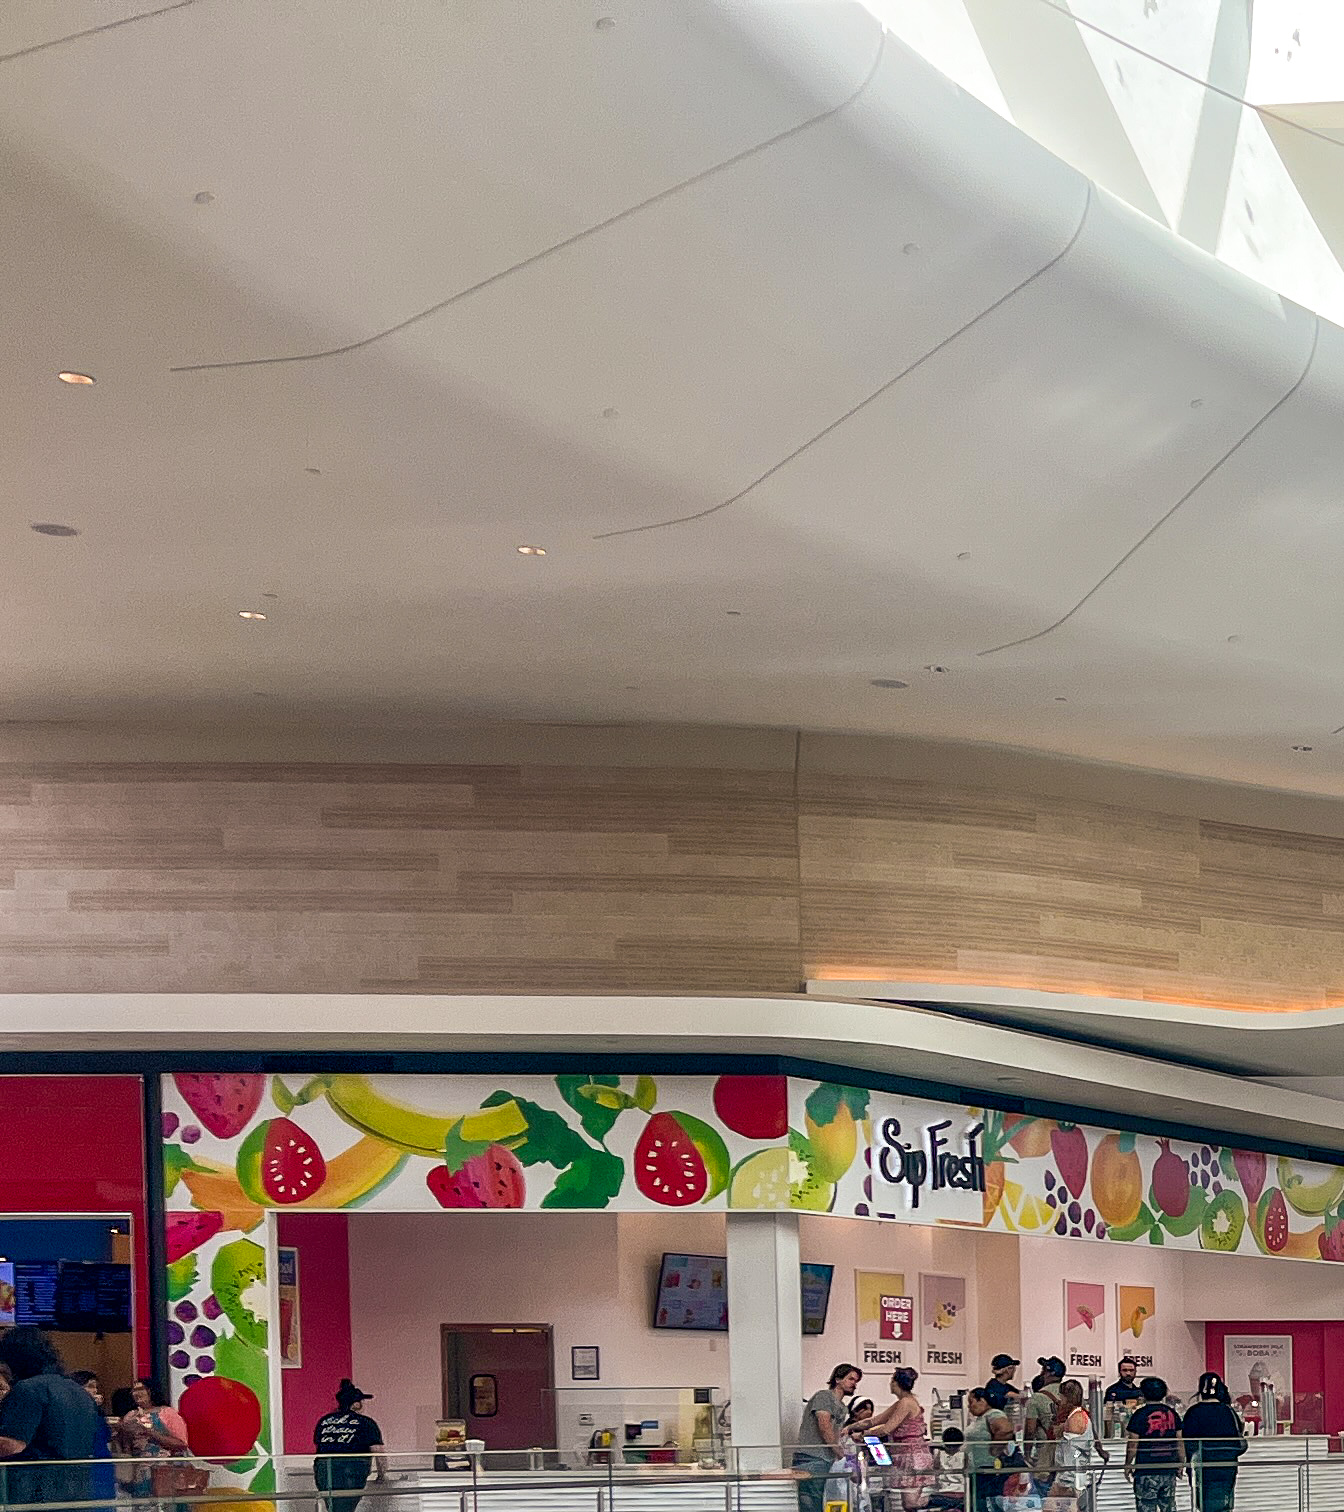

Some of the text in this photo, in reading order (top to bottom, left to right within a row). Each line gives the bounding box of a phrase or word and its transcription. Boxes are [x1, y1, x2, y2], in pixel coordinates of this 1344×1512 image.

[879, 1118, 986, 1208] Sip Fresh
[881, 1296, 912, 1309] ORDER
[885, 1310, 909, 1322] HERE
[863, 1350, 902, 1363] FRESH
[927, 1350, 963, 1364] FRESH
[1070, 1354, 1102, 1367] FRESH
